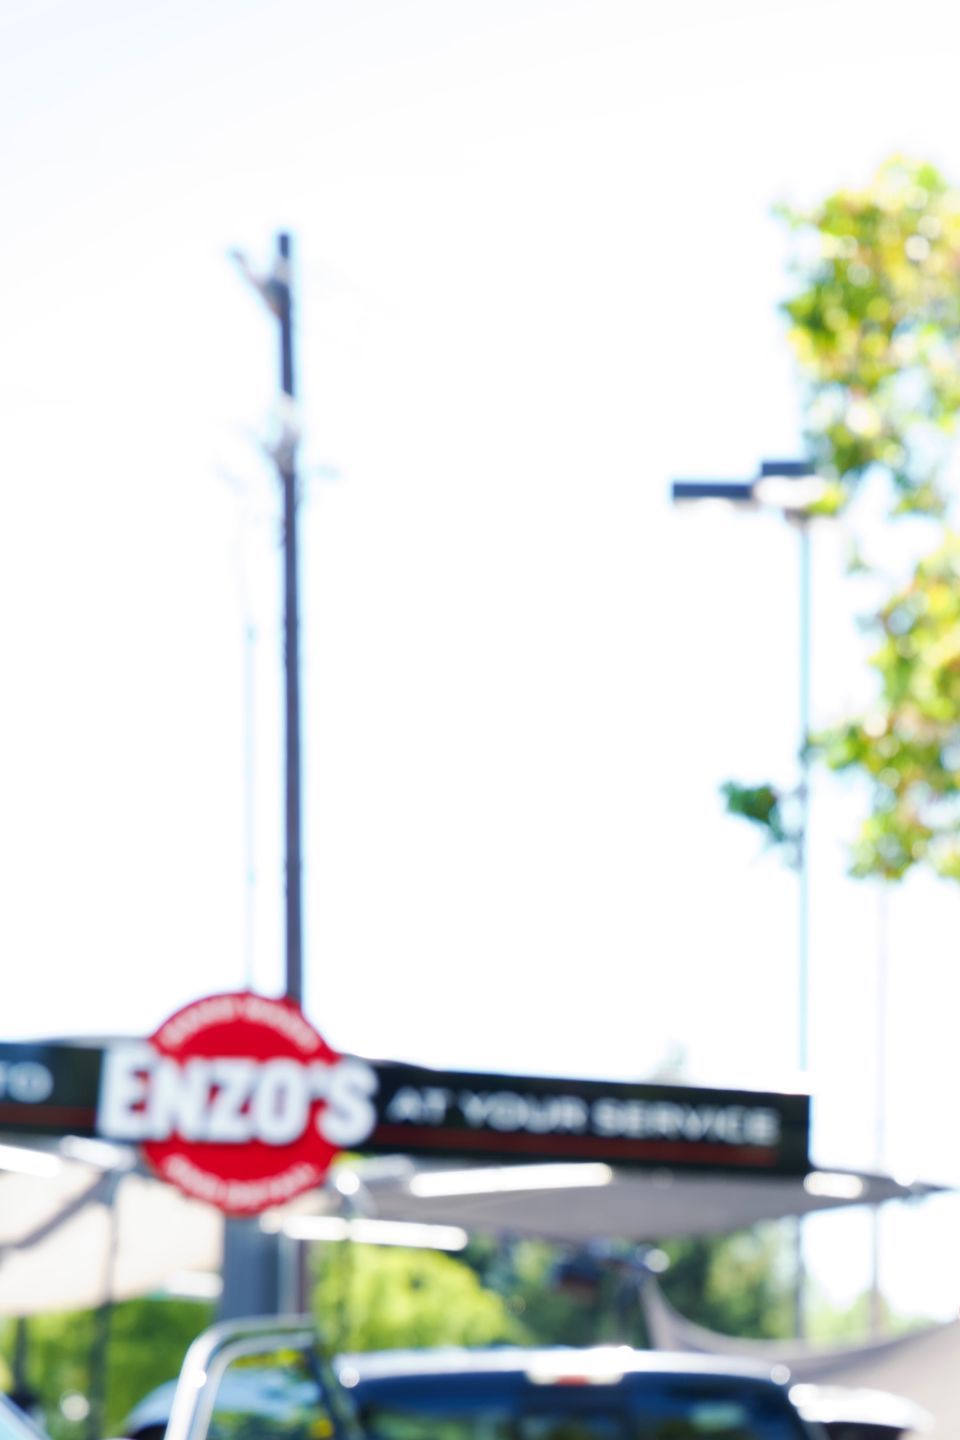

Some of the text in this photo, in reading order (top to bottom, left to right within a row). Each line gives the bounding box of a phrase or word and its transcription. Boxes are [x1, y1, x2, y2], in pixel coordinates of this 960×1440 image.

[0, 1060, 54, 1104] O
[98, 1040, 377, 1146] ENZO'S
[387, 1086, 780, 1147] AT YOUR SERVICE
